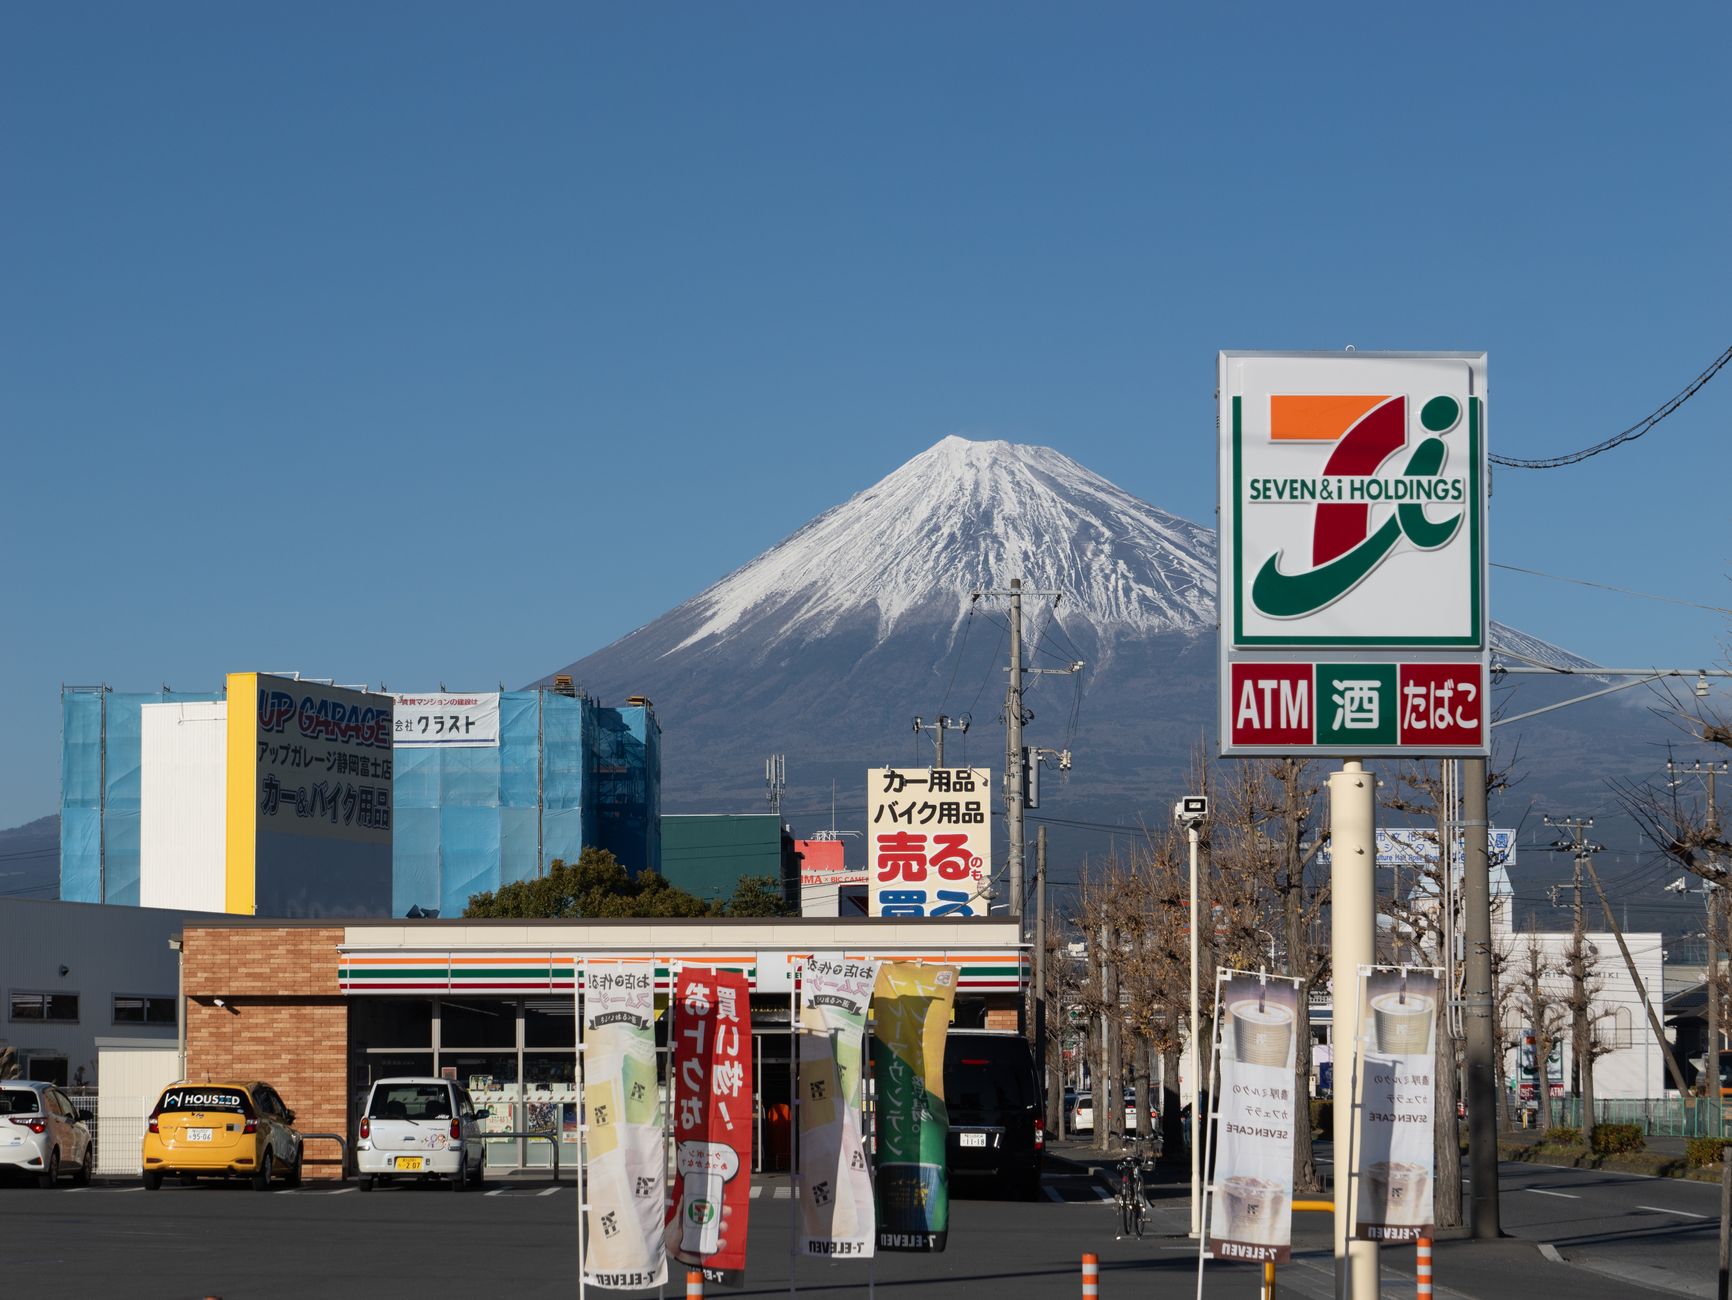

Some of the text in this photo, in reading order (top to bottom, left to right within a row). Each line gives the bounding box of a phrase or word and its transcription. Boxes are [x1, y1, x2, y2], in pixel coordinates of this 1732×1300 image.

[1350, 478, 1462, 501] HOLDINGS
[258, 689, 391, 750] UP GARAGE
[1237, 679, 1309, 729] ATM
[1331, 679, 1382, 730] 酒
[1403, 678, 1479, 730] たばこ
[418, 715, 476, 735] クラスト
[258, 741, 391, 780] アップガレージ静岡富士店
[883, 769, 975, 793] カー用品
[261, 773, 391, 830] カー&バイク用品
[874, 801, 985, 824] バイク用品
[1376, 854, 1393, 862] ulture
[1550, 1087, 1564, 1097] ATM
